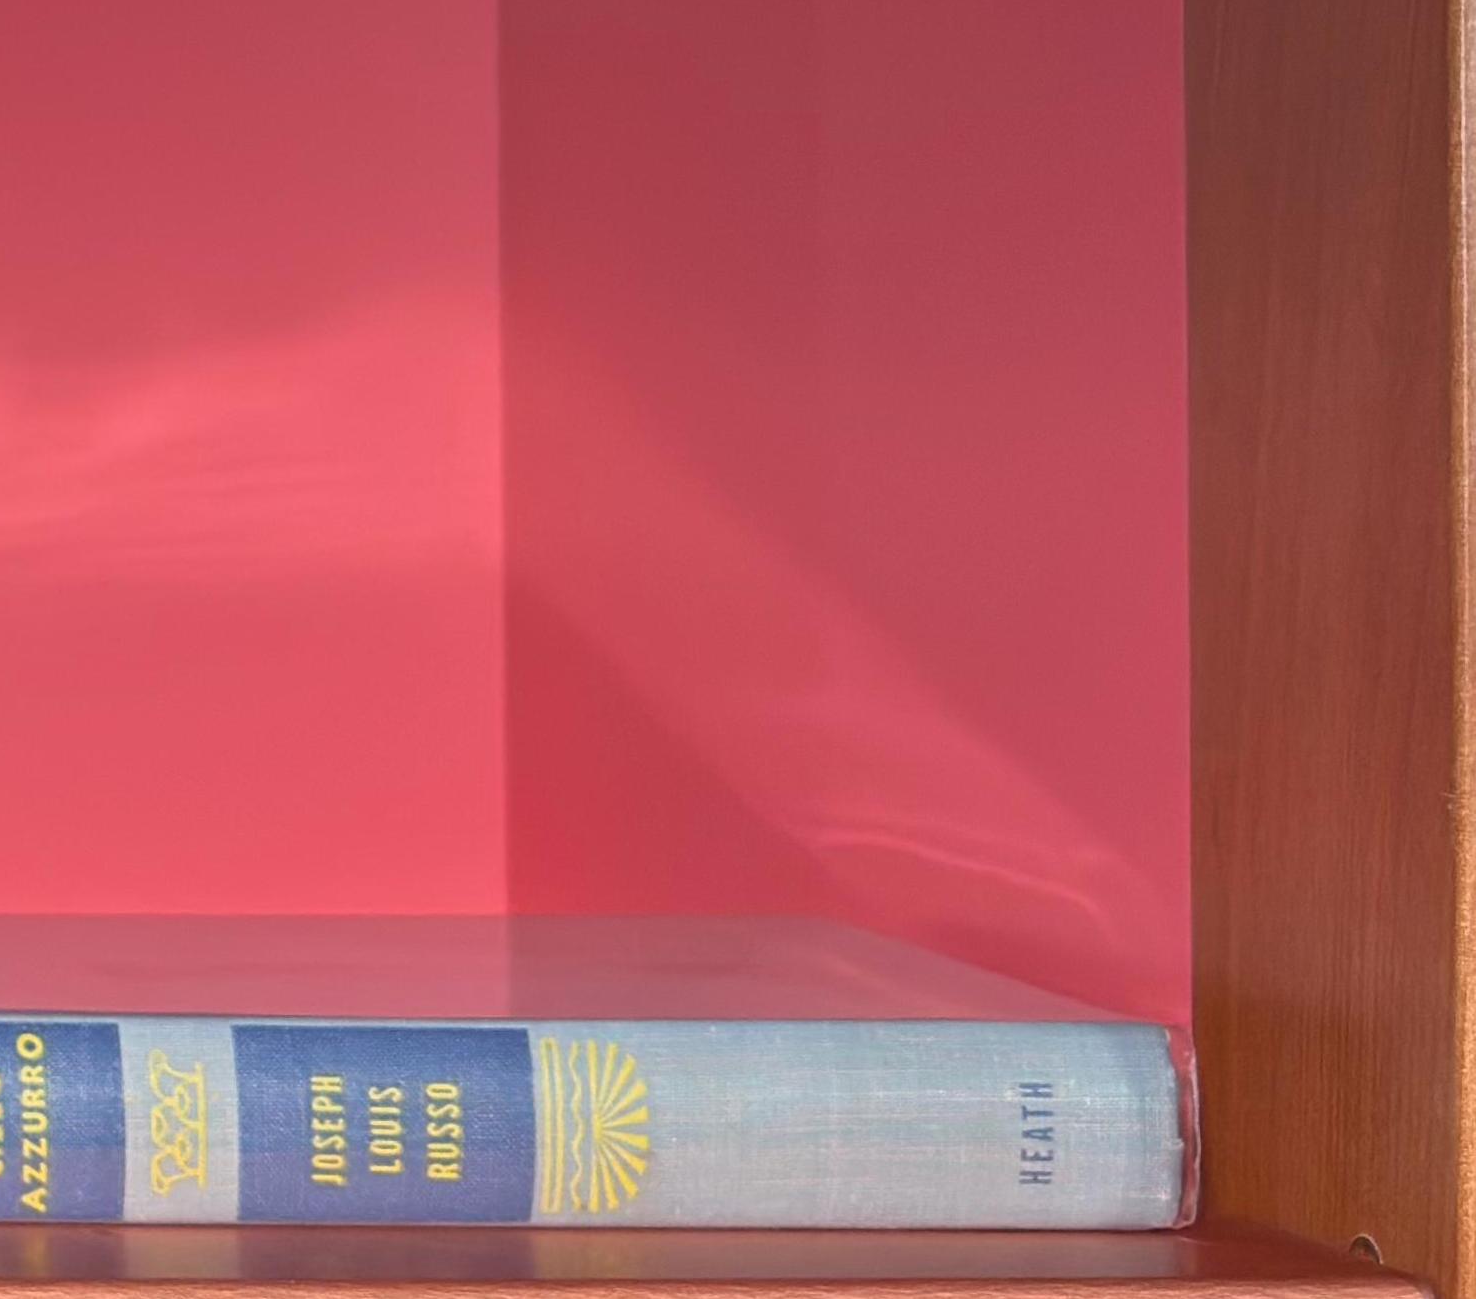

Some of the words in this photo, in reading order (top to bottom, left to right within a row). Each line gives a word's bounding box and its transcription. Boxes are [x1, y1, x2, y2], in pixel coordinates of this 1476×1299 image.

[16, 1032, 50, 1214] AZZURRO
[310, 1074, 347, 1187] JOSEPH
[368, 1084, 405, 1175] LOUIS
[425, 1081, 463, 1182] RUSSO
[1019, 1081, 1054, 1185] HEATH
